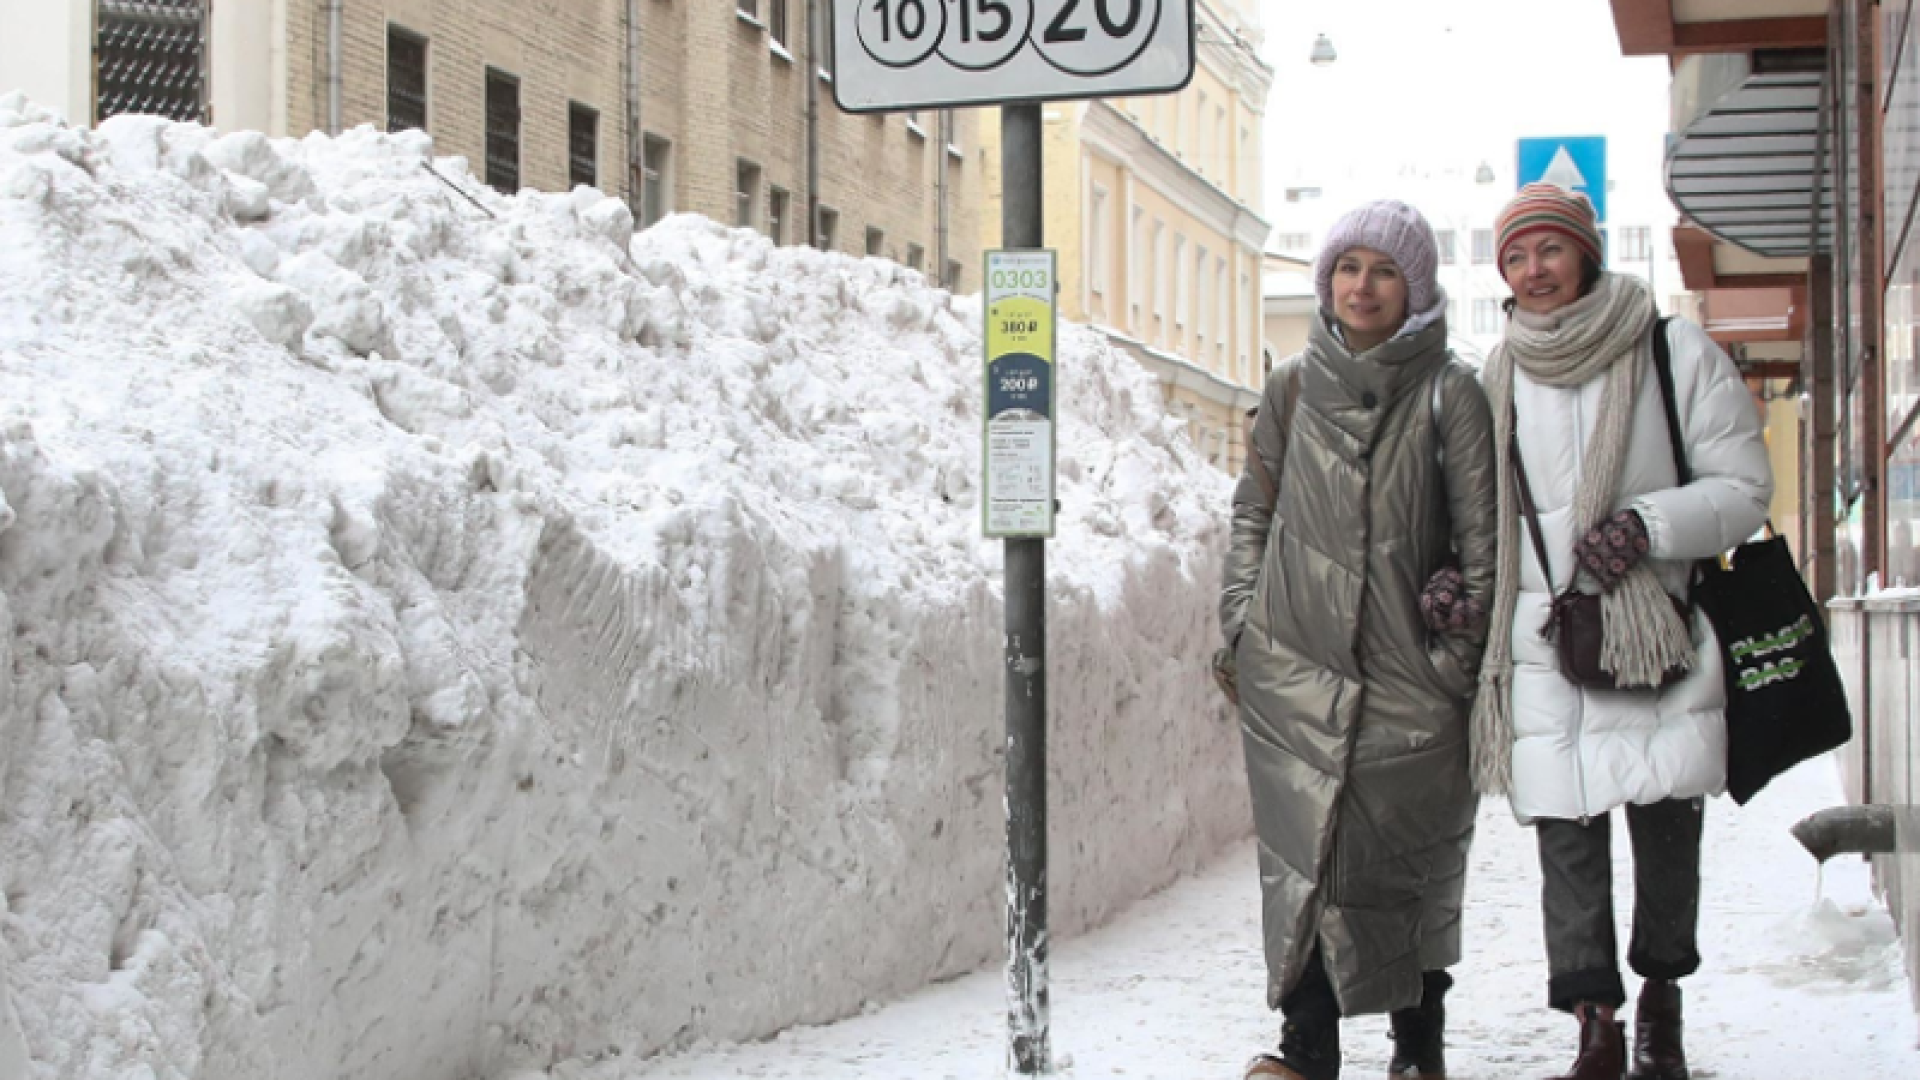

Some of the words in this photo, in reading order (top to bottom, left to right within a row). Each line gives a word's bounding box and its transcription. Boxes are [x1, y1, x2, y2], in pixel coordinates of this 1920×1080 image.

[873, 0, 926, 42] 10
[950, 0, 1012, 43] 15
[1043, 0, 1141, 43] 20
[992, 269, 1047, 289] 0303
